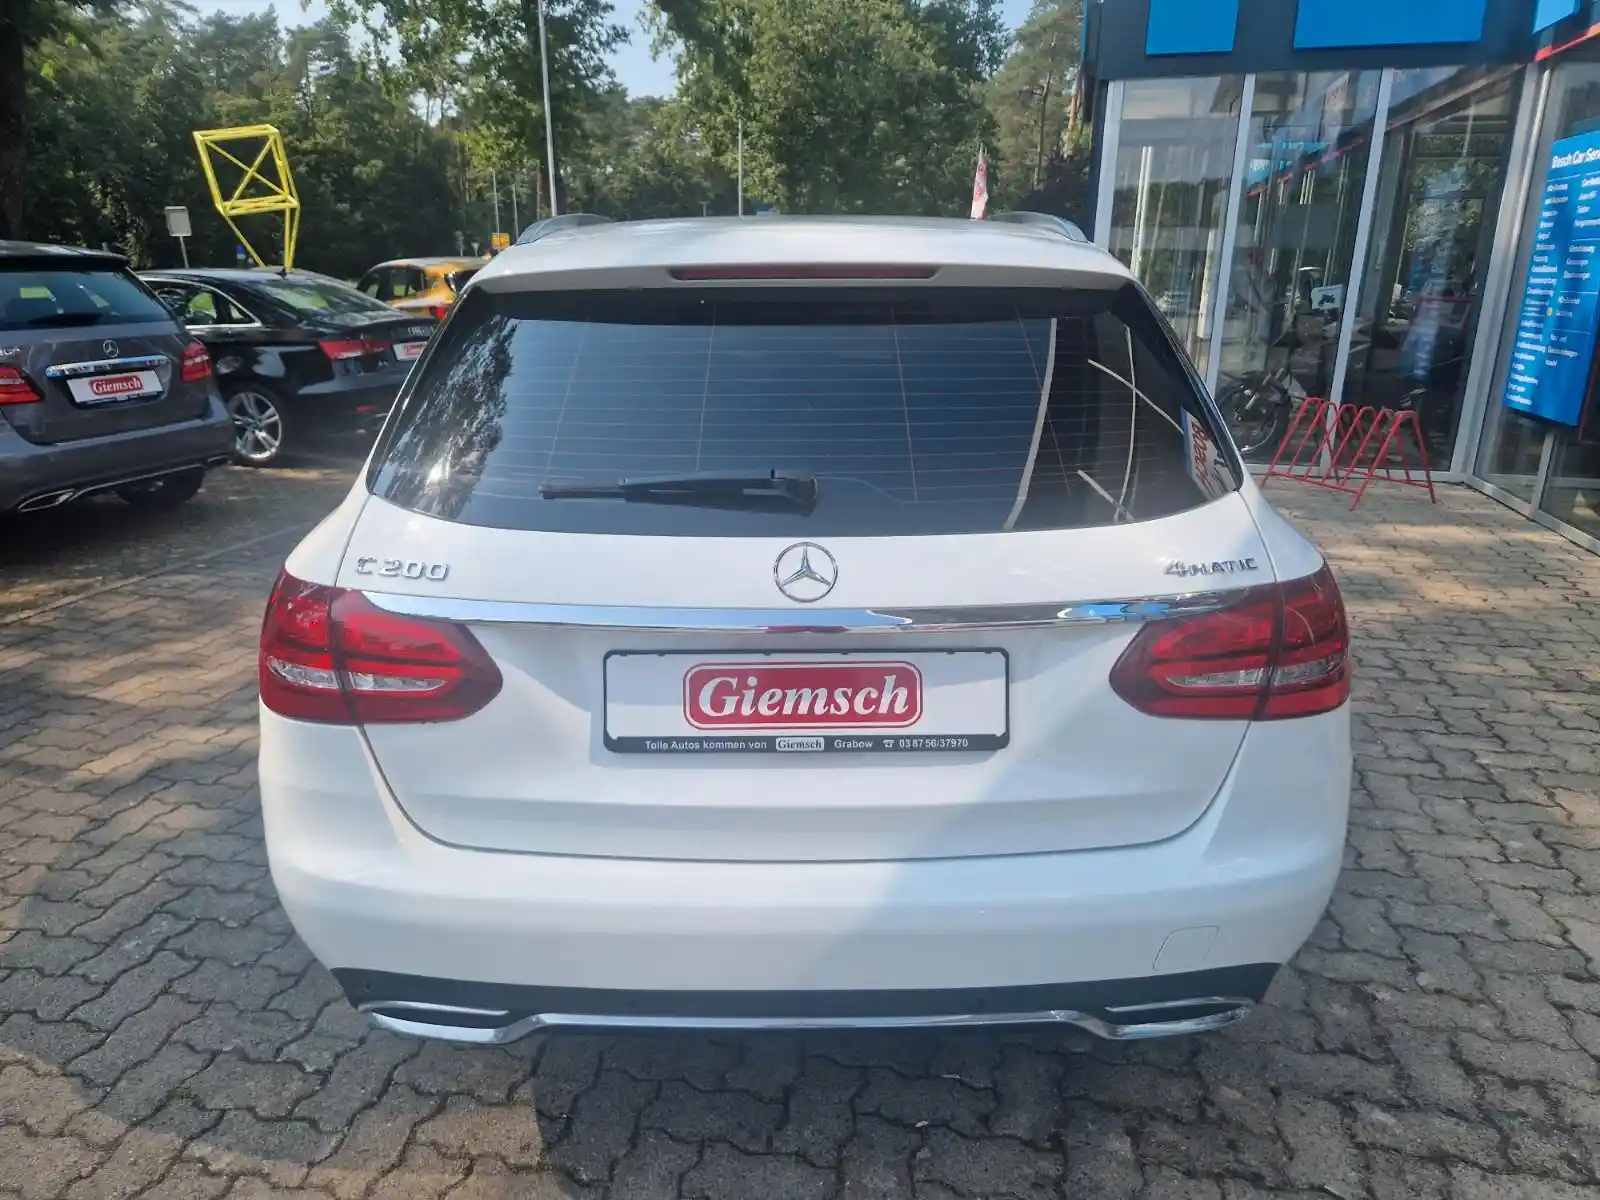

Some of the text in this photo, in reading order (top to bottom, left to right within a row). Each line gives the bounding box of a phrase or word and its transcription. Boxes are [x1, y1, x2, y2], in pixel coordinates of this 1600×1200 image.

[91, 376, 141, 394] Giemsch
[356, 556, 450, 581] C 200
[1164, 557, 1259, 578] 4MATIC
[699, 674, 909, 717] Giemsch
[670, 740, 701, 750] Autos
[703, 739, 746, 750] kommen
[749, 740, 767, 750] von
[777, 737, 823, 750] Giemsch
[834, 738, 873, 749] Grabow
